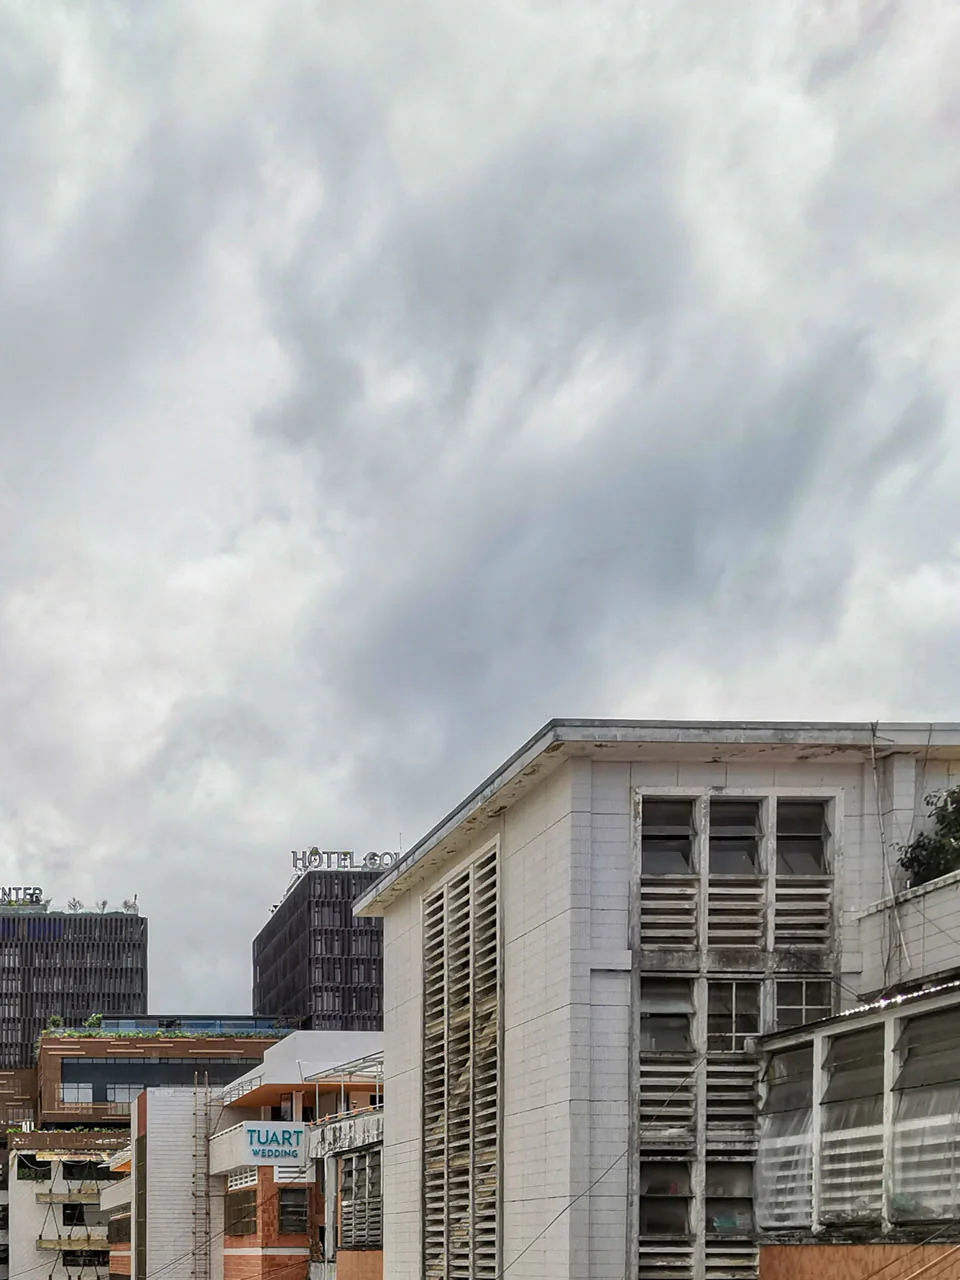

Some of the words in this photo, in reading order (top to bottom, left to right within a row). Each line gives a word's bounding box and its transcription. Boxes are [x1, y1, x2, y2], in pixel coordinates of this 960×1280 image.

[291, 849, 361, 869] HOTEL
[246, 1129, 304, 1146] TUART
[252, 1149, 298, 1158] WEDDING
